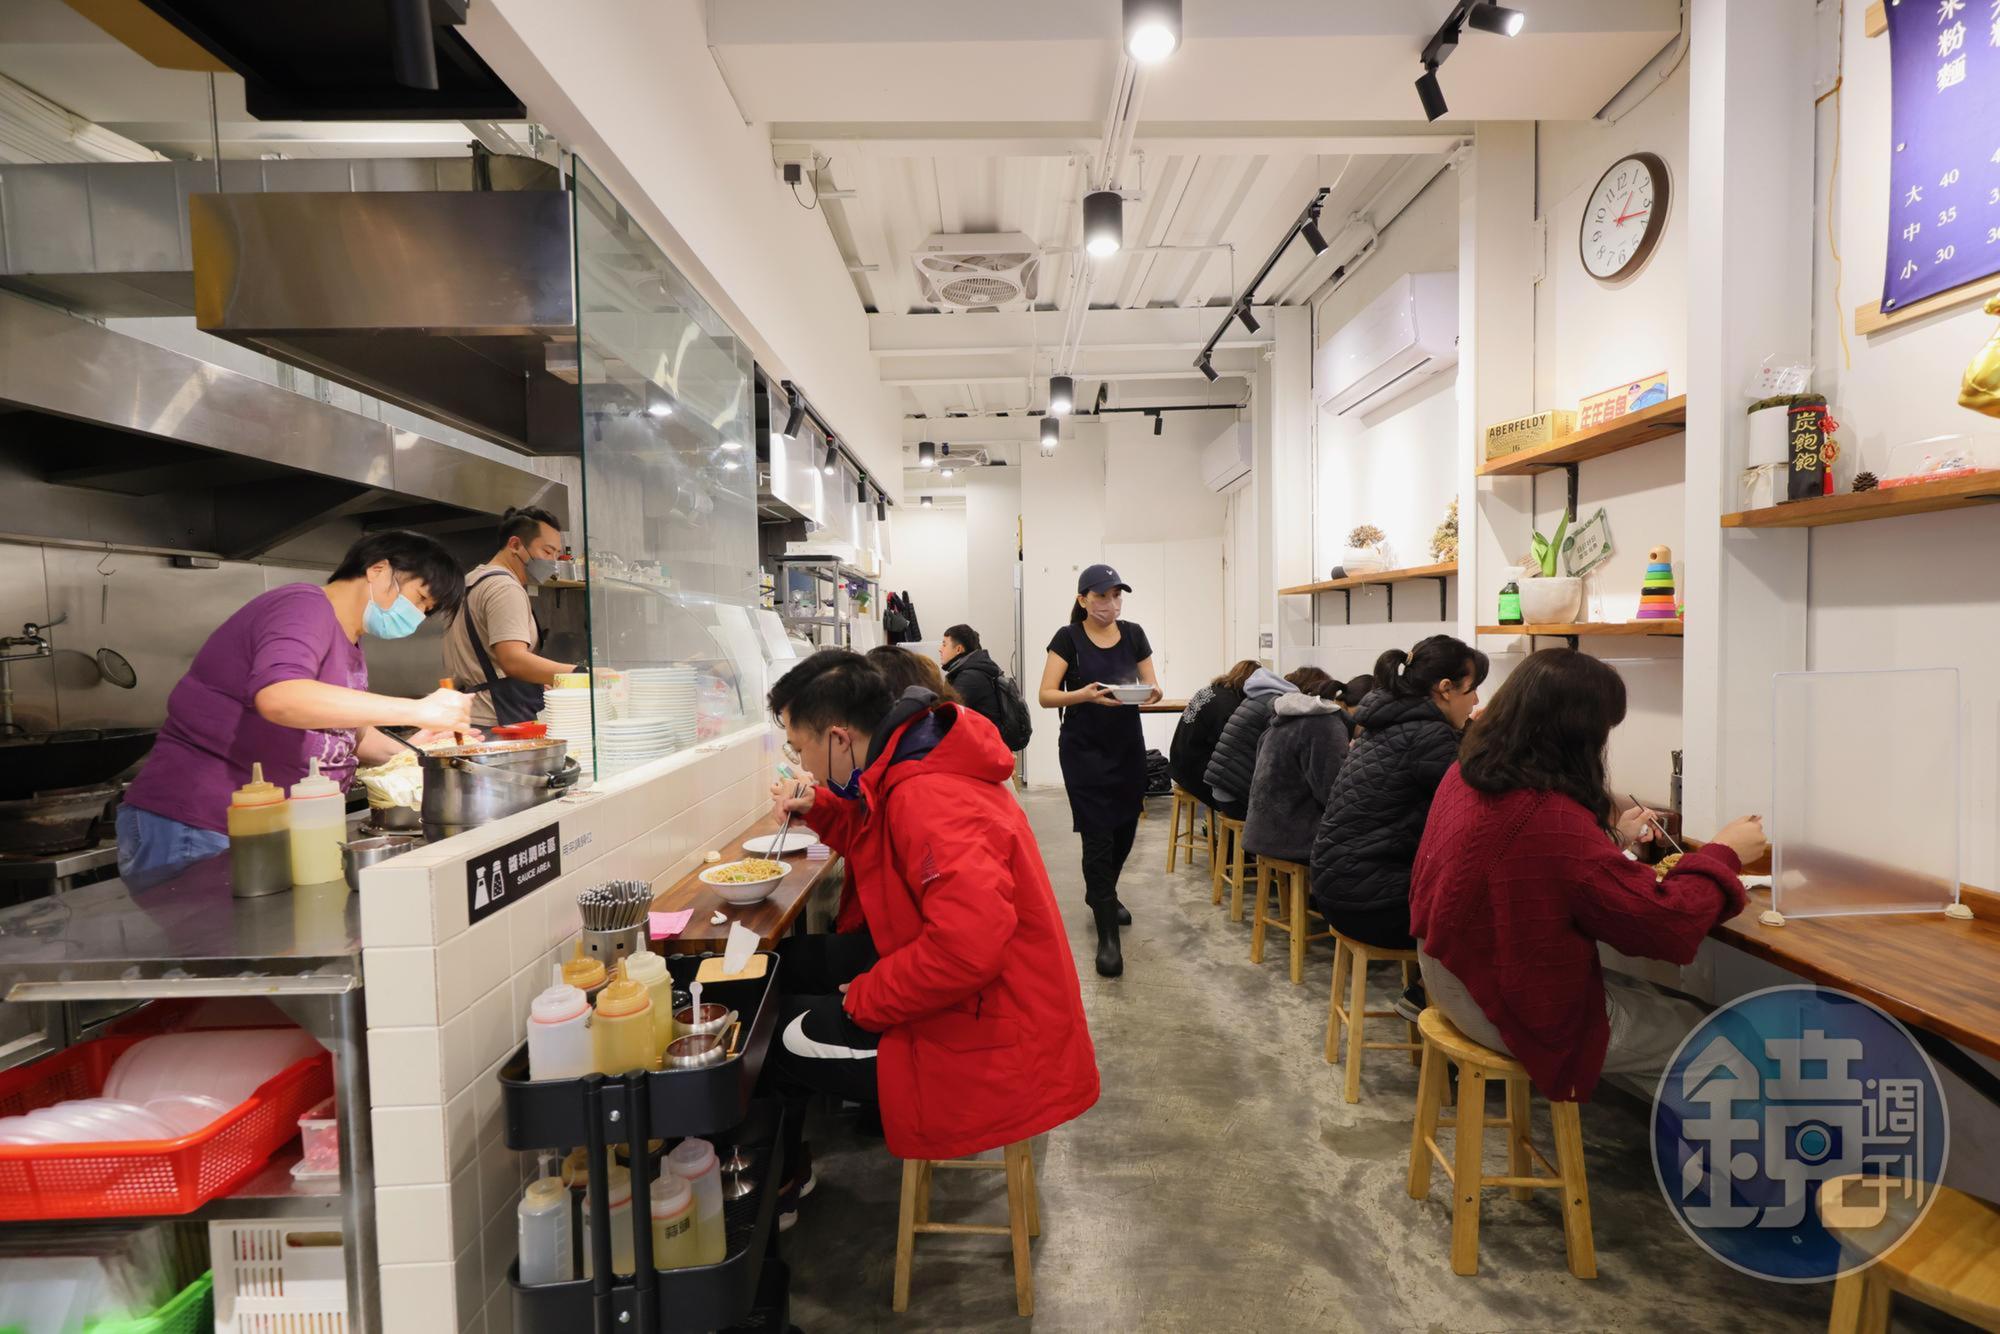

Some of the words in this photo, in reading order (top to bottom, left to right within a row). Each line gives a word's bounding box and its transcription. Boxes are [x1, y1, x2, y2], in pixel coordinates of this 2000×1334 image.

[1617, 172, 1627, 191] 12
[1639, 176, 1650, 193] 2
[1904, 185, 1923, 207] 大
[1939, 168, 1959, 189] 40
[1606, 188, 1615, 203] 11
[1595, 207, 1606, 223] 10
[1903, 222, 1921, 243] 中
[1937, 207, 1957, 227] 35
[1900, 259, 1918, 280] 小
[1935, 245, 1955, 265] 30
[1489, 414, 1546, 438] ABERFELDY
[1792, 411, 1817, 472] 炭飽飽
[508, 836, 556, 874] 醬料調味區
[517, 867, 536, 885] SAUCE
[536, 861, 551, 876] AREA
